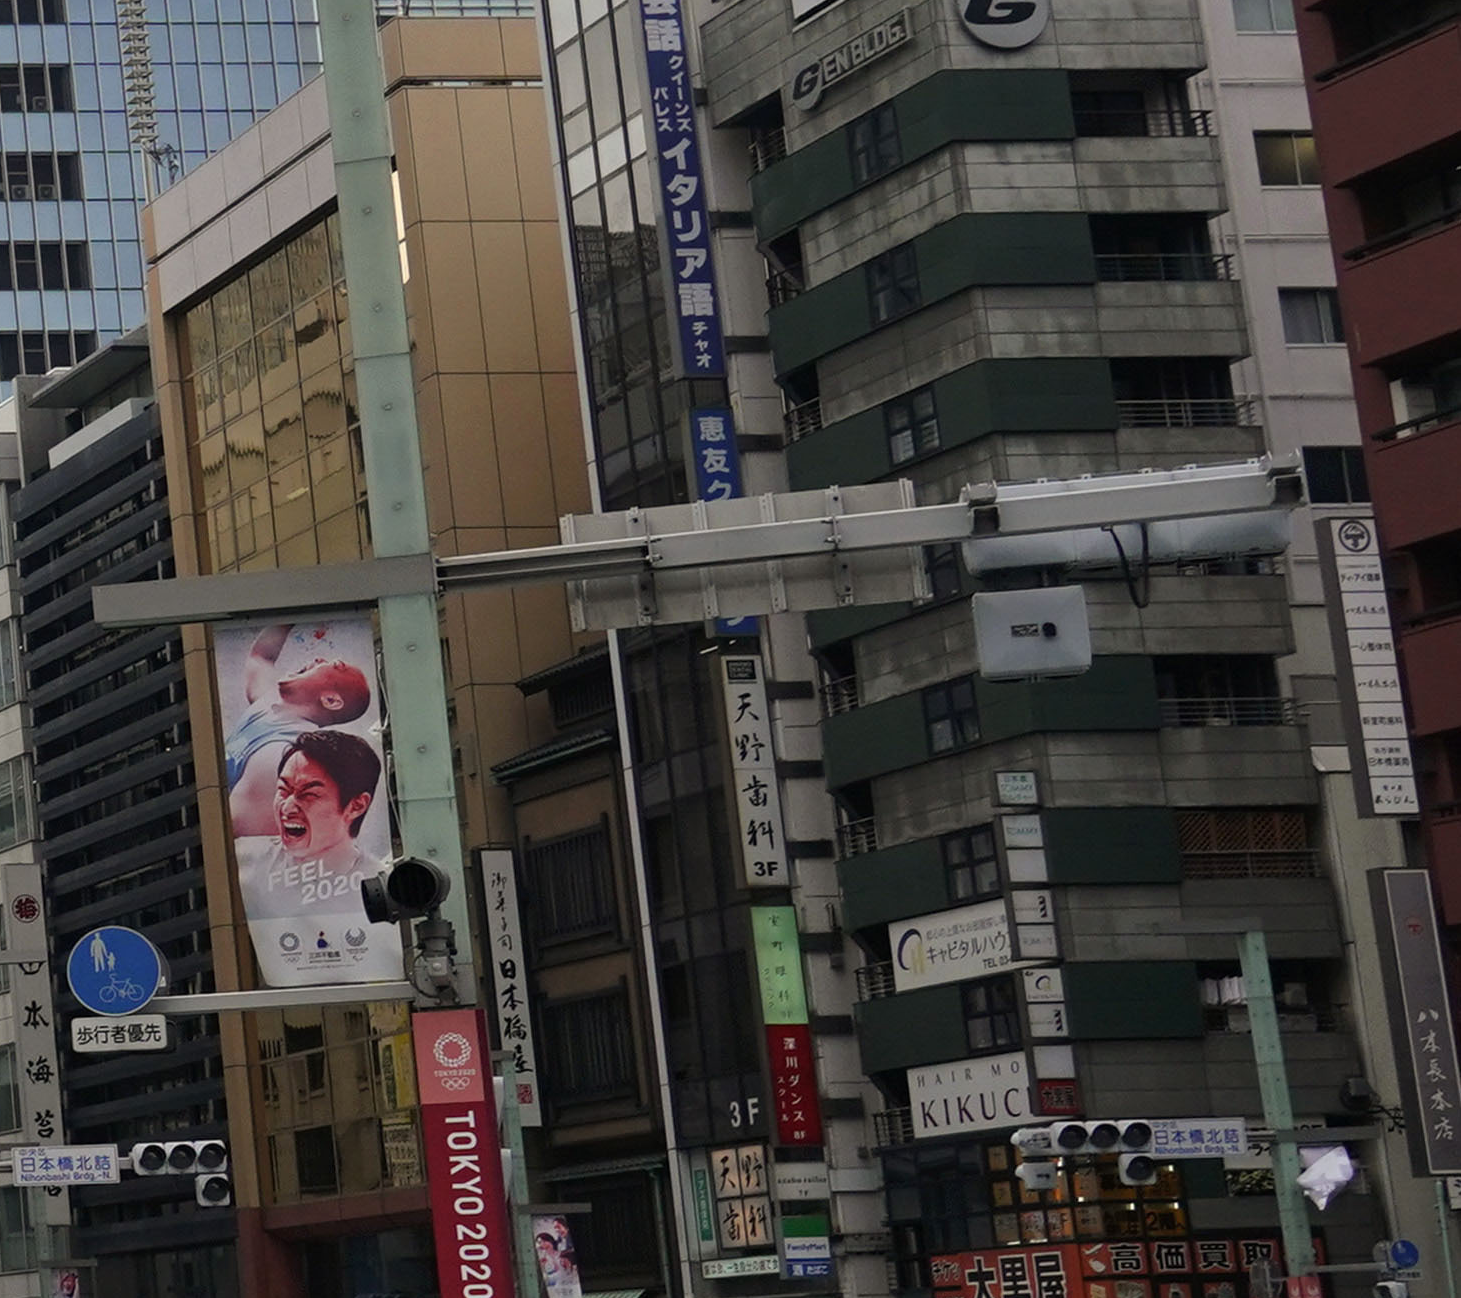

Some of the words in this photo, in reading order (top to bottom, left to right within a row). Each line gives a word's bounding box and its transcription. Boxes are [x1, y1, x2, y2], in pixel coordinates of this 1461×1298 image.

[654, 87, 673, 132] パレス
[668, 55, 693, 132] クイーンズ
[663, 138, 714, 316] イタリア語
[692, 321, 713, 369] チャオ
[734, 693, 775, 849] 天野歯科
[269, 859, 334, 891] FEEL
[754, 862, 778, 877] 3F
[302, 871, 365, 904] 2020
[927, 930, 1010, 964] キャピタルハウ
[983, 958, 998, 969] TEL
[77, 1024, 161, 1044] 歩行者優先
[917, 1068, 972, 1088] HAIR
[921, 1086, 1034, 1128] KIKUC
[1154, 1128, 1239, 1145] 日本橋北詰
[20, 1156, 111, 1173] 日本橋北詰
[21, 1172, 70, 1181] Nihonbashi
[445, 1110, 485, 1215] TOKYO
[787, 1242, 827, 1253] FamilyMart
[1109, 1241, 1273, 1271] 高価買取
